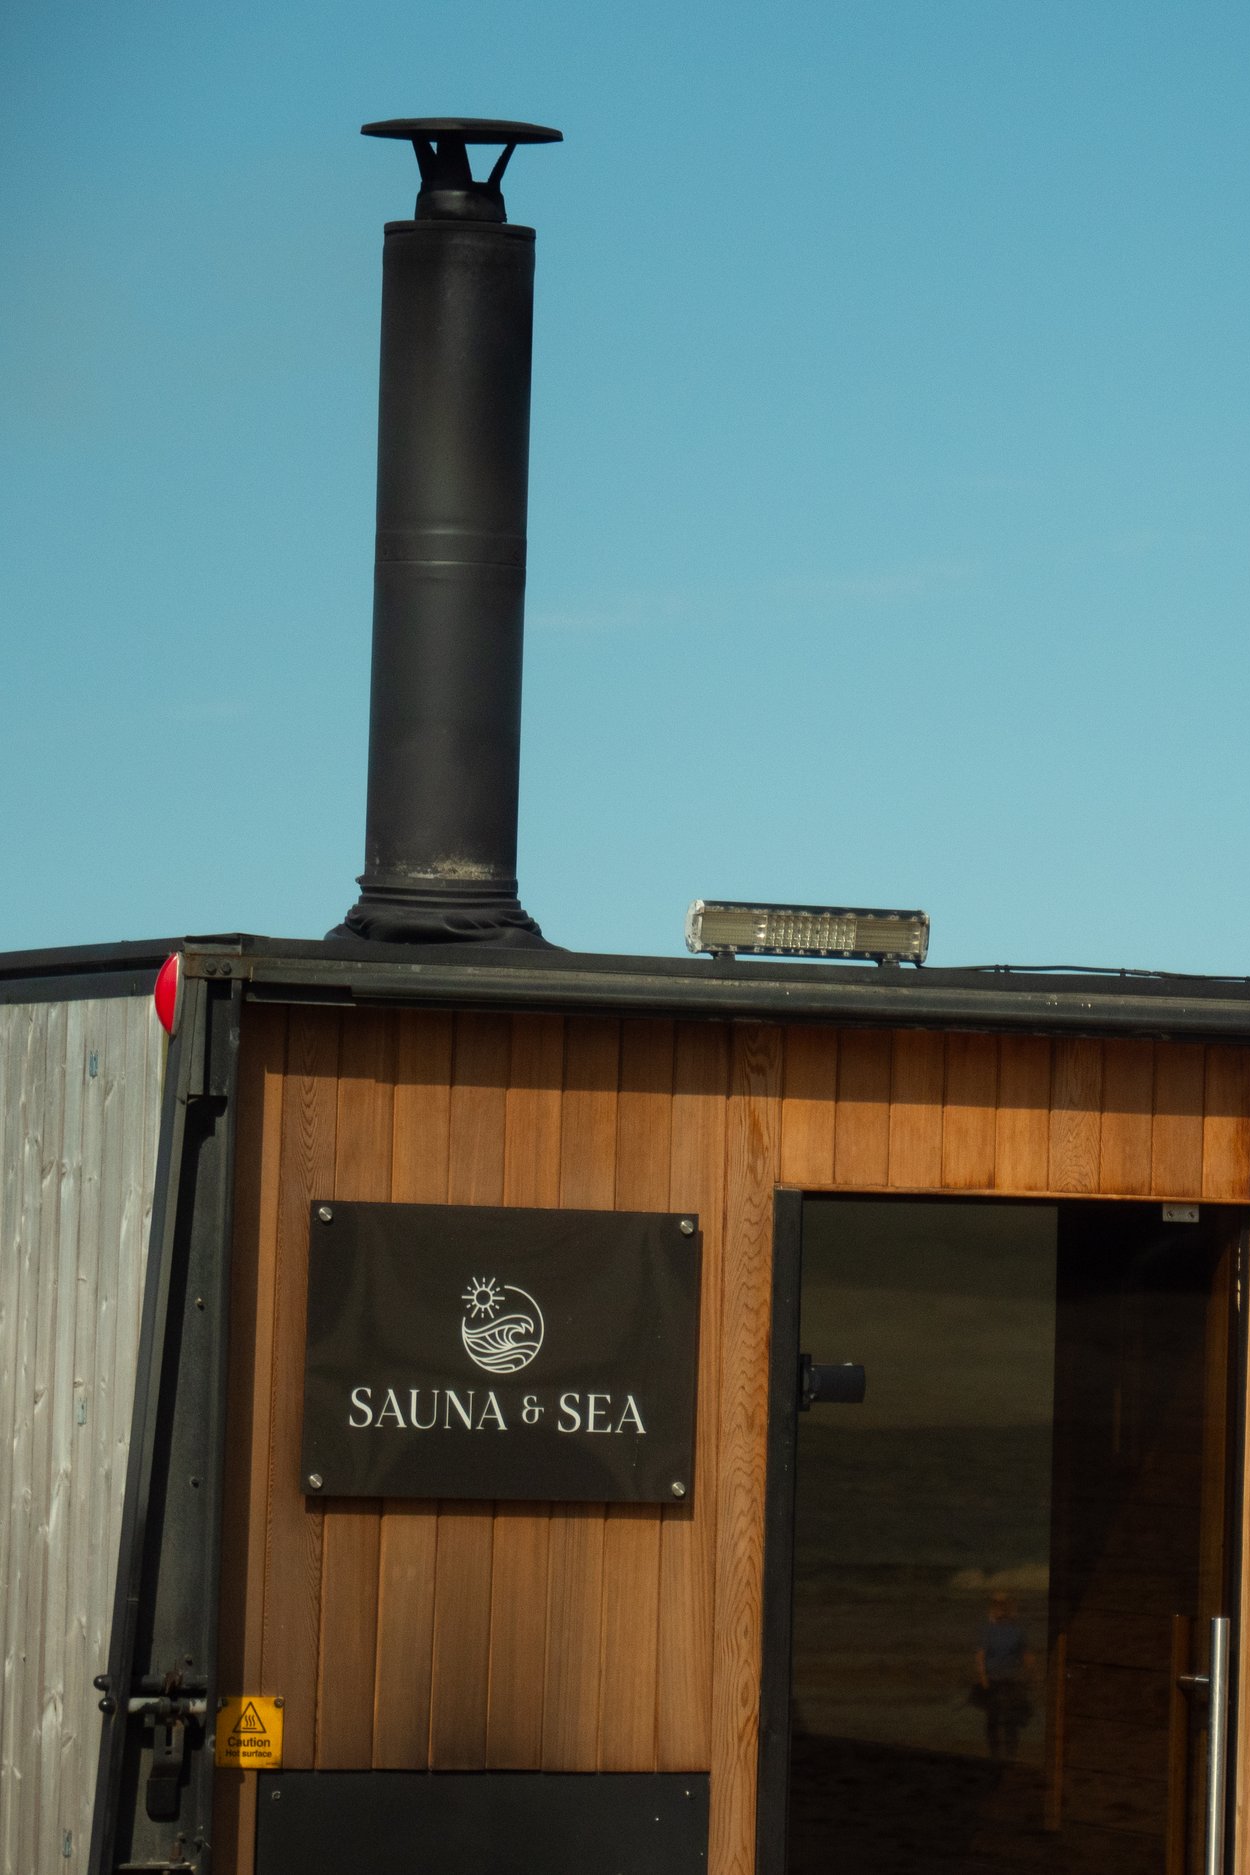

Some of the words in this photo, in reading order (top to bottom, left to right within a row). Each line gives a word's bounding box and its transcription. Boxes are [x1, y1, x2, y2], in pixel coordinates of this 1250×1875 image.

[349, 1387, 508, 1431] SAUNA
[521, 1395, 545, 1425] &
[557, 1392, 647, 1434] SEA
[227, 1736, 271, 1748] Caution
[225, 1749, 240, 1757] Hot
[242, 1750, 272, 1758] surface
